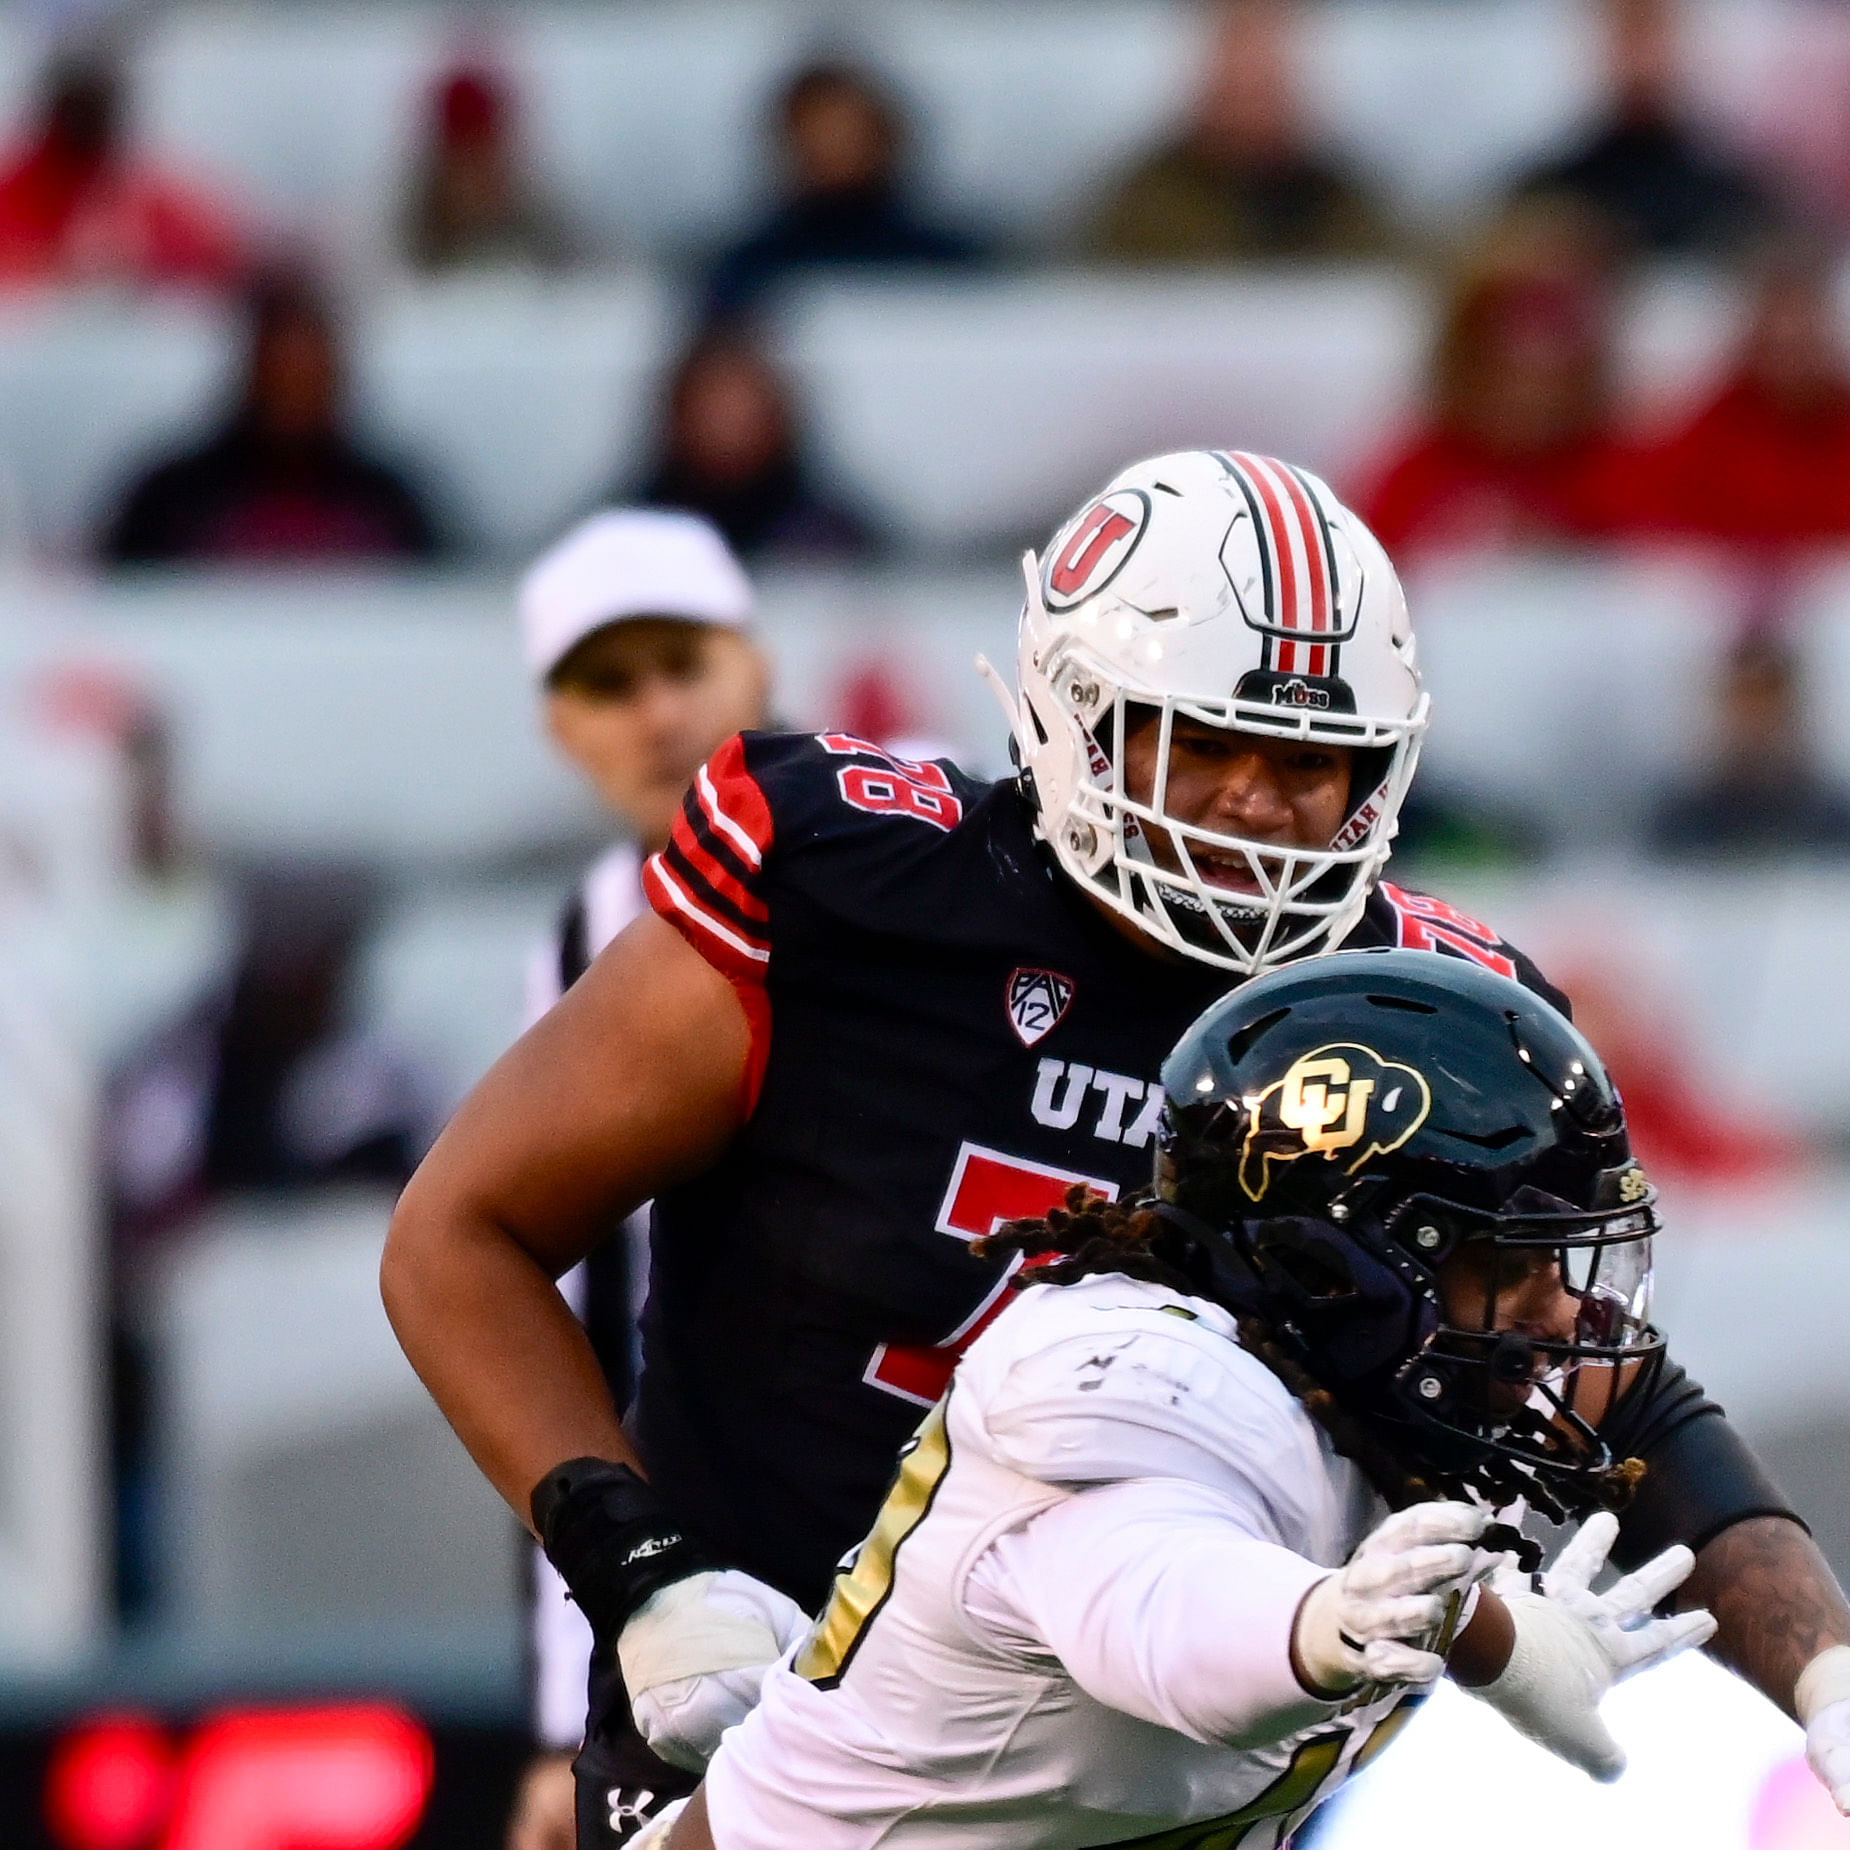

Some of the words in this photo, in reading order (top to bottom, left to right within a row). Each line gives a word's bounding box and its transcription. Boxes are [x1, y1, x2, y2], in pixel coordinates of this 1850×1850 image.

[1051, 503, 1137, 597] U
[814, 732, 963, 833] 78
[1379, 880, 1519, 982] 78
[1017, 1000, 1051, 1031] 12
[1030, 1056, 1166, 1150] UTA
[1279, 1057, 1375, 1150] CU
